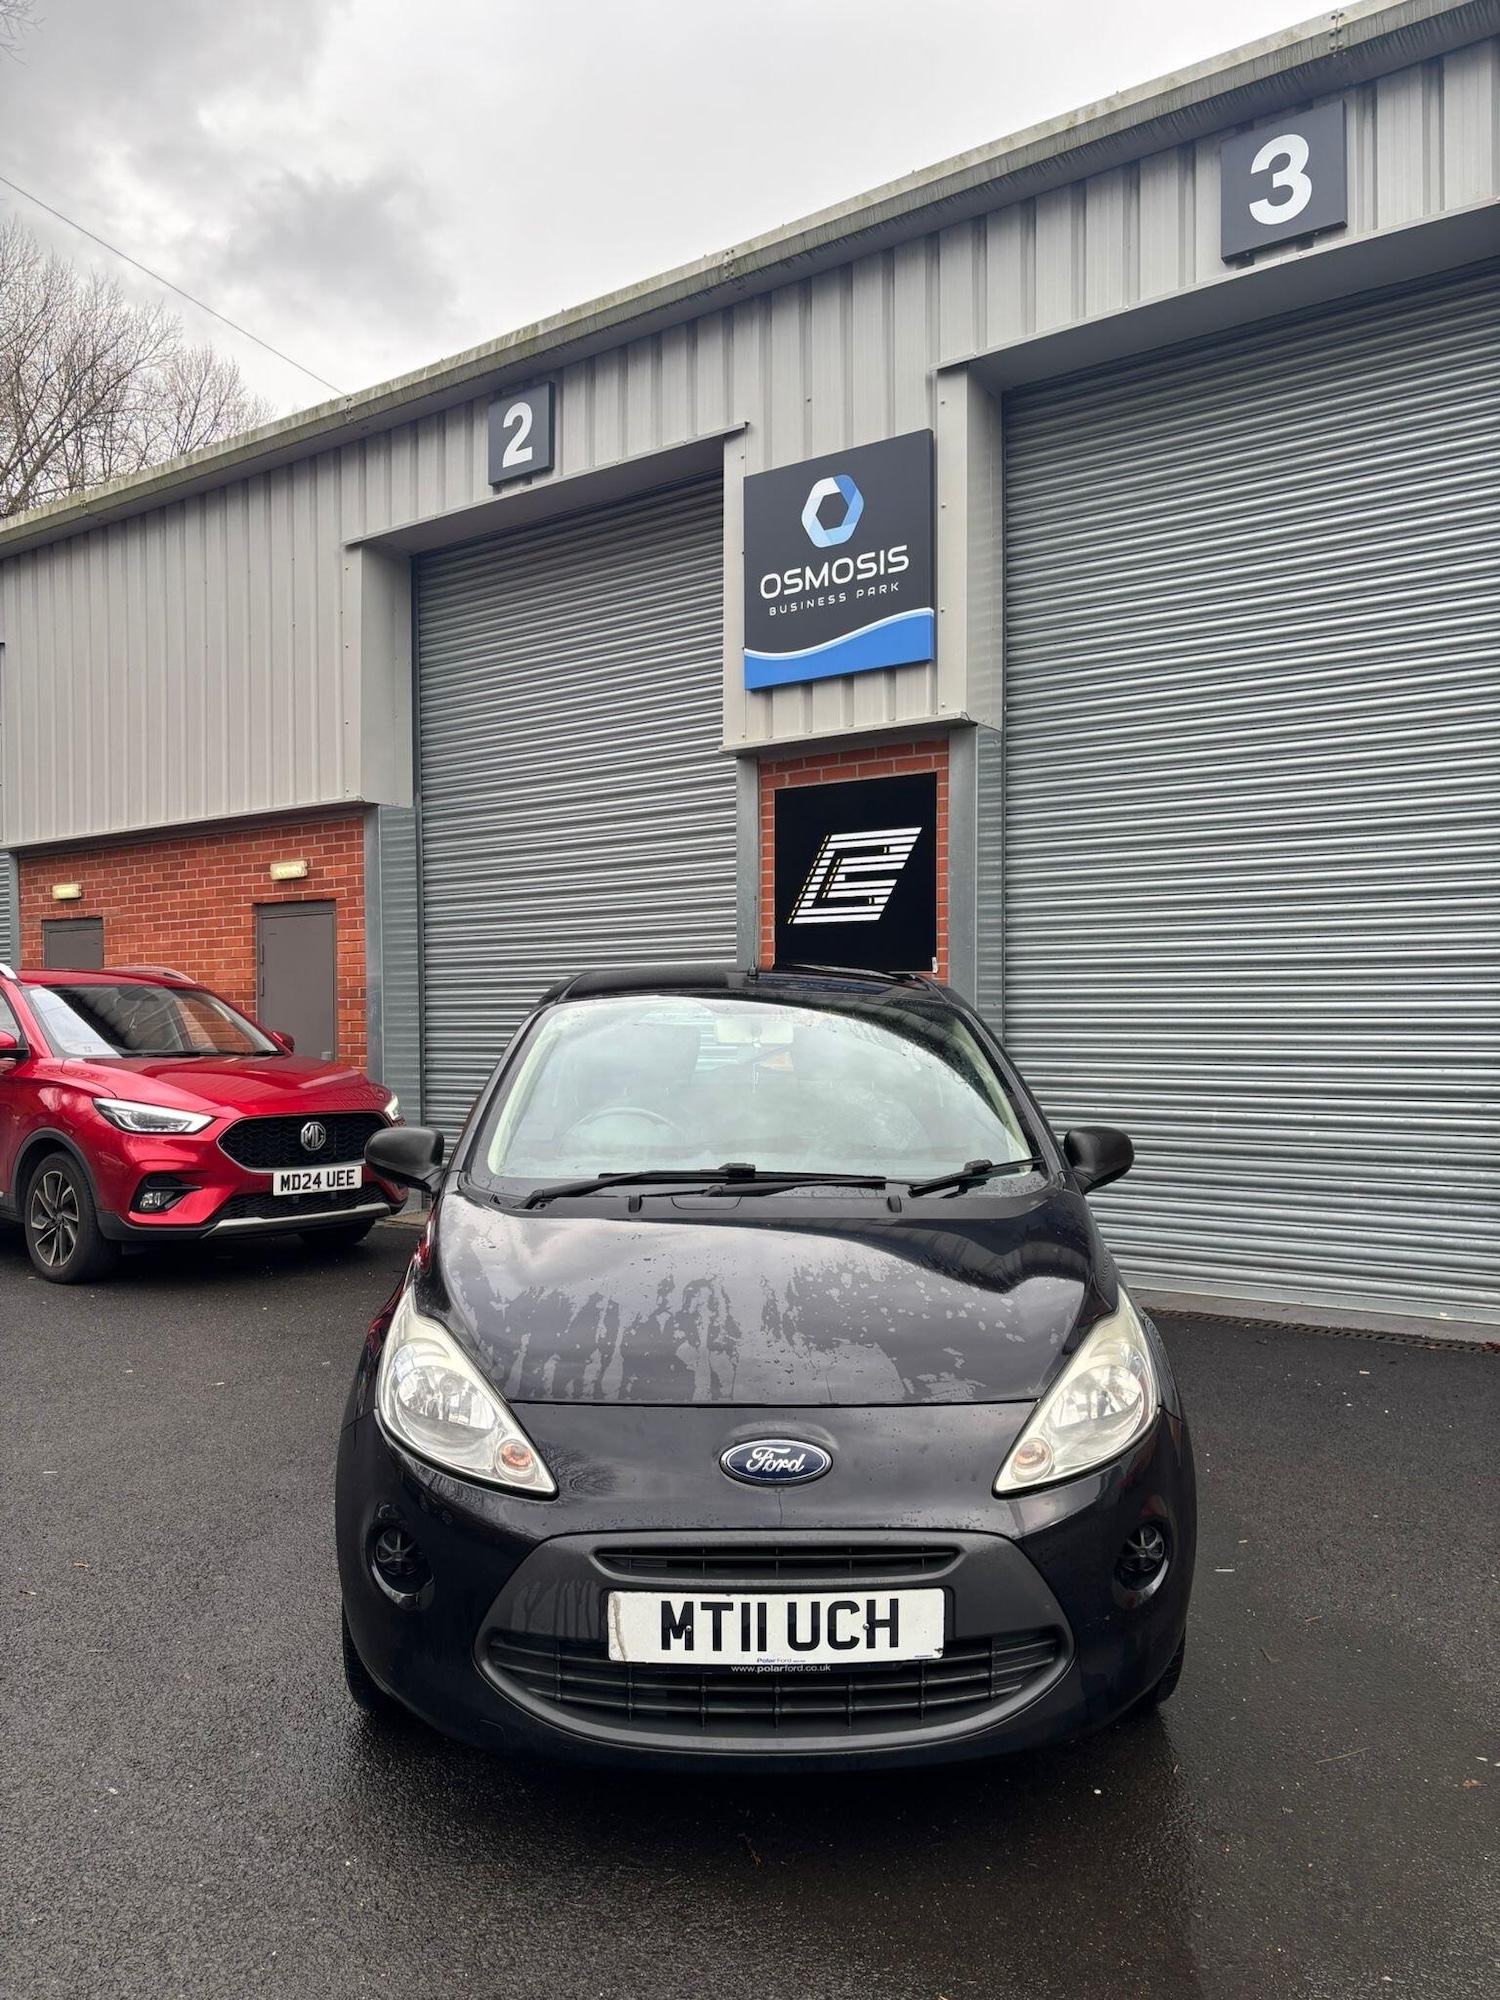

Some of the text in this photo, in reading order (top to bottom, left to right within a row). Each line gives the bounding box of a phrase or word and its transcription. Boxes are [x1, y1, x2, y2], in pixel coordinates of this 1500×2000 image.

[1249, 133, 1313, 226] 3
[502, 401, 533, 469] 2
[760, 544, 910, 600] OSMOSIS
[769, 581, 900, 616] BUSINESS PARK
[303, 1124, 326, 1149] MG
[280, 1169, 356, 1191] MD24 UEE
[745, 1446, 807, 1473] Ford
[660, 1598, 899, 1652] MT11 UCH
[731, 1664, 831, 1673] www.polarford.co.uk
